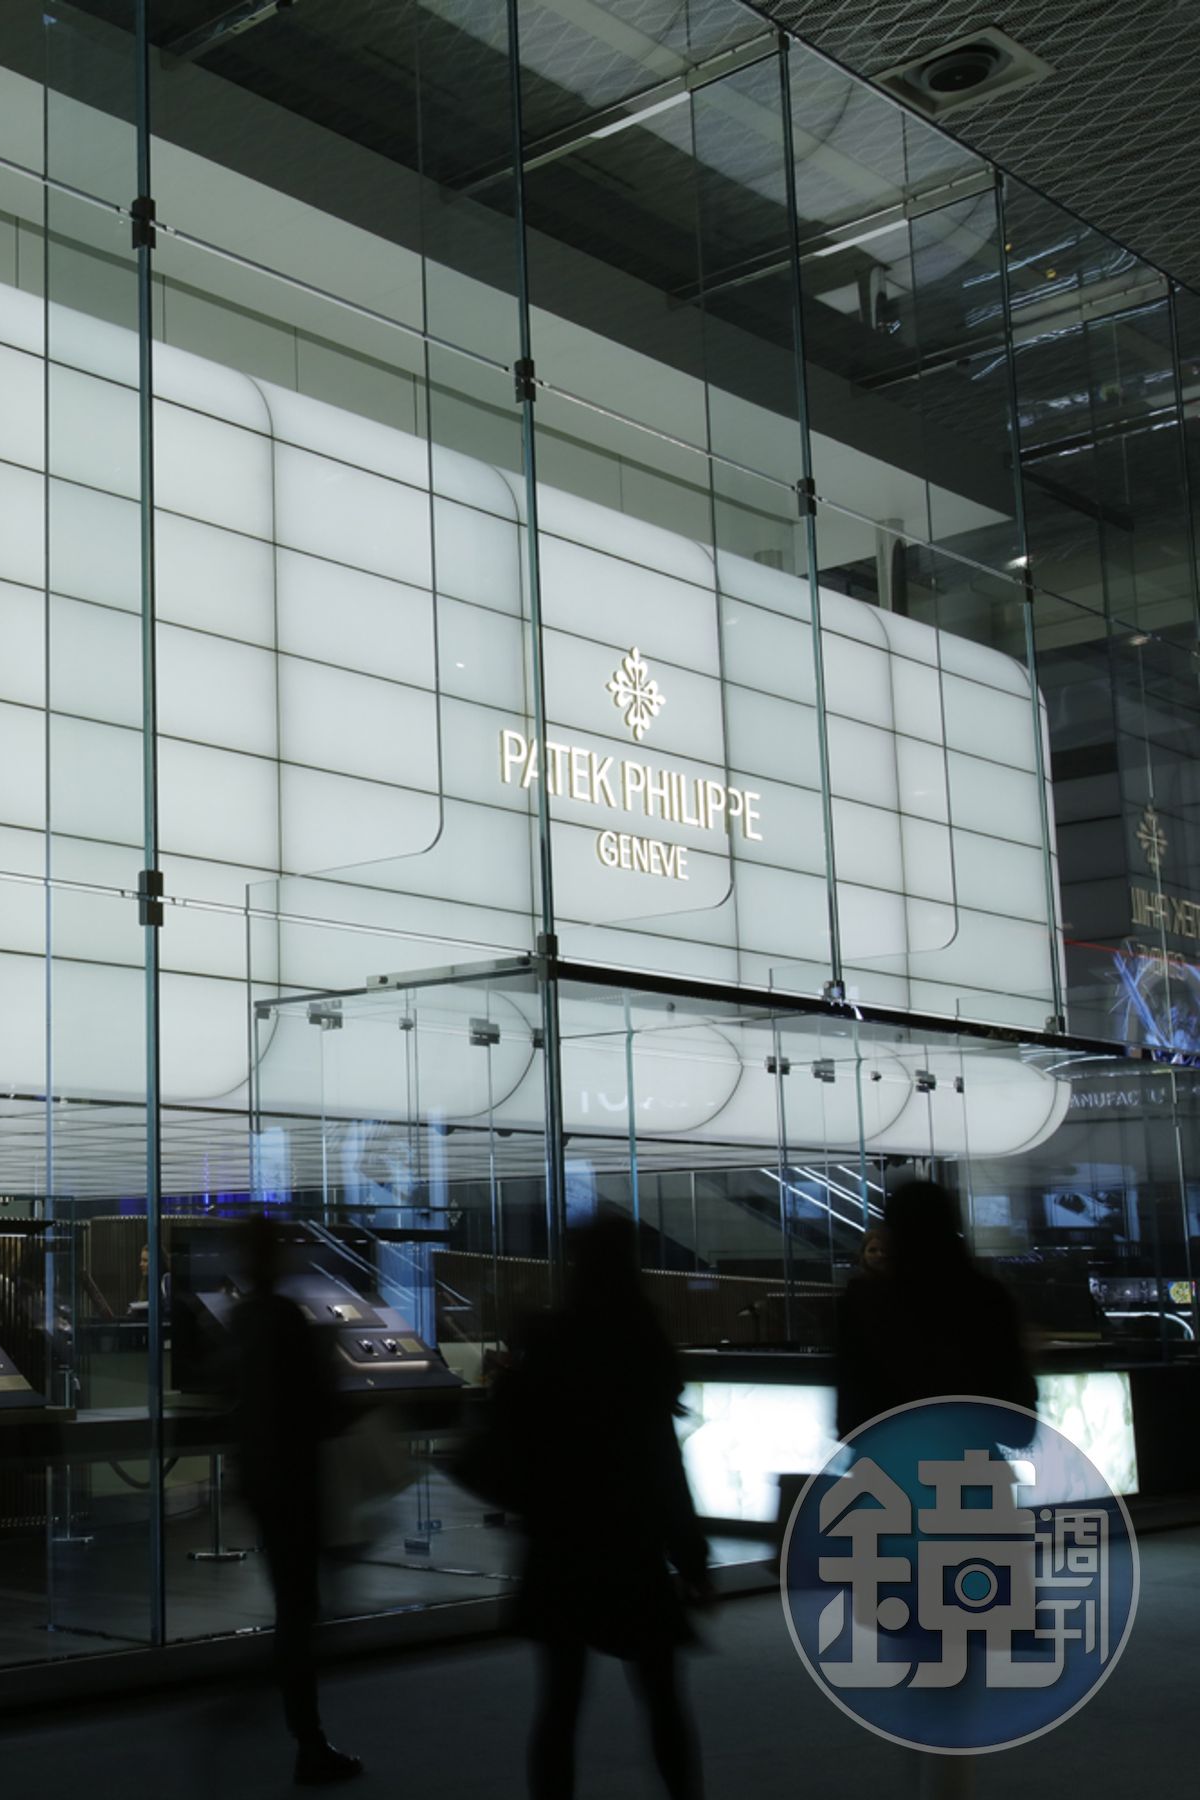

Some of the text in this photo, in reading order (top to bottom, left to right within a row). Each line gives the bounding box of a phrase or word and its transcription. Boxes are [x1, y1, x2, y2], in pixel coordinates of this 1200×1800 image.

[500, 729, 763, 841] PATEK PHILIPPE
[597, 830, 689, 880] GENEVE
